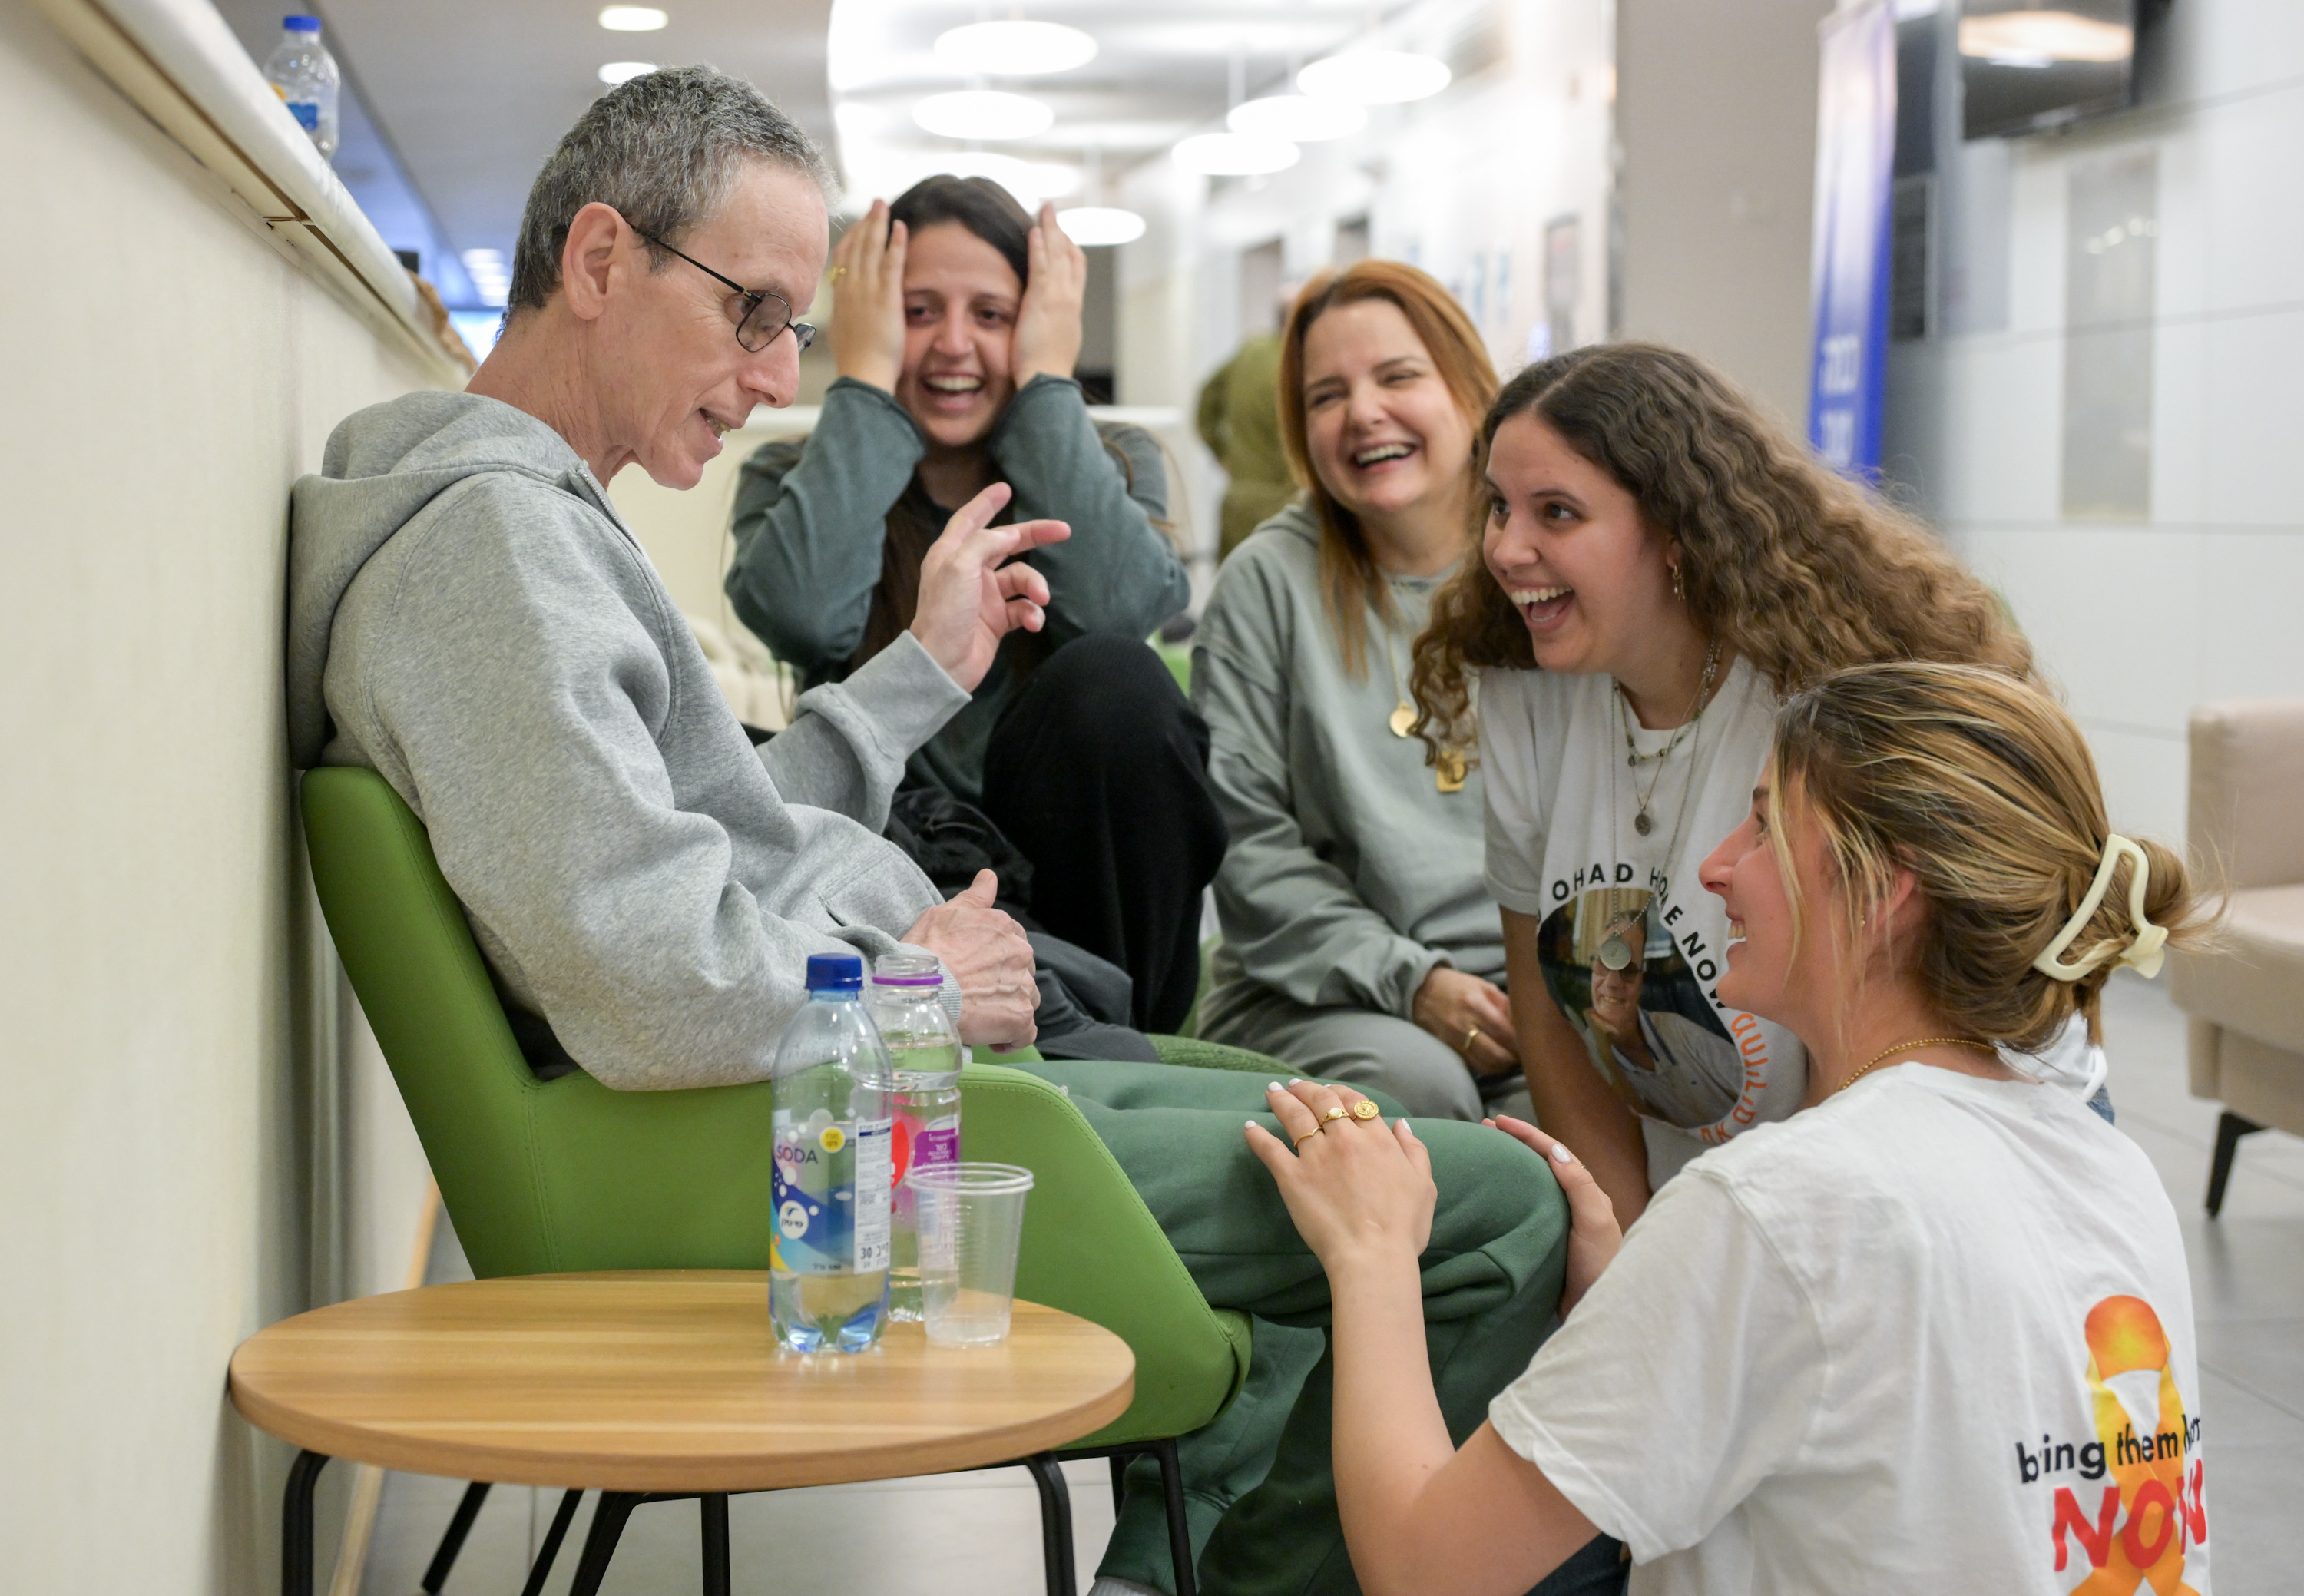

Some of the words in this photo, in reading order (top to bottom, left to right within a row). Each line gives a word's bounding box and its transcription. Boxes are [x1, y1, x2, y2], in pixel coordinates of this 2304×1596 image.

[1552, 863, 1634, 901] OHAD
[1730, 1012, 1769, 1124] מחזירים
[774, 1144, 819, 1165] SODA
[860, 1247, 872, 1260] 30
[2014, 1433, 2107, 1484] bing
[2117, 1422, 2179, 1466] them
[2051, 1459, 2207, 1572] NOW
